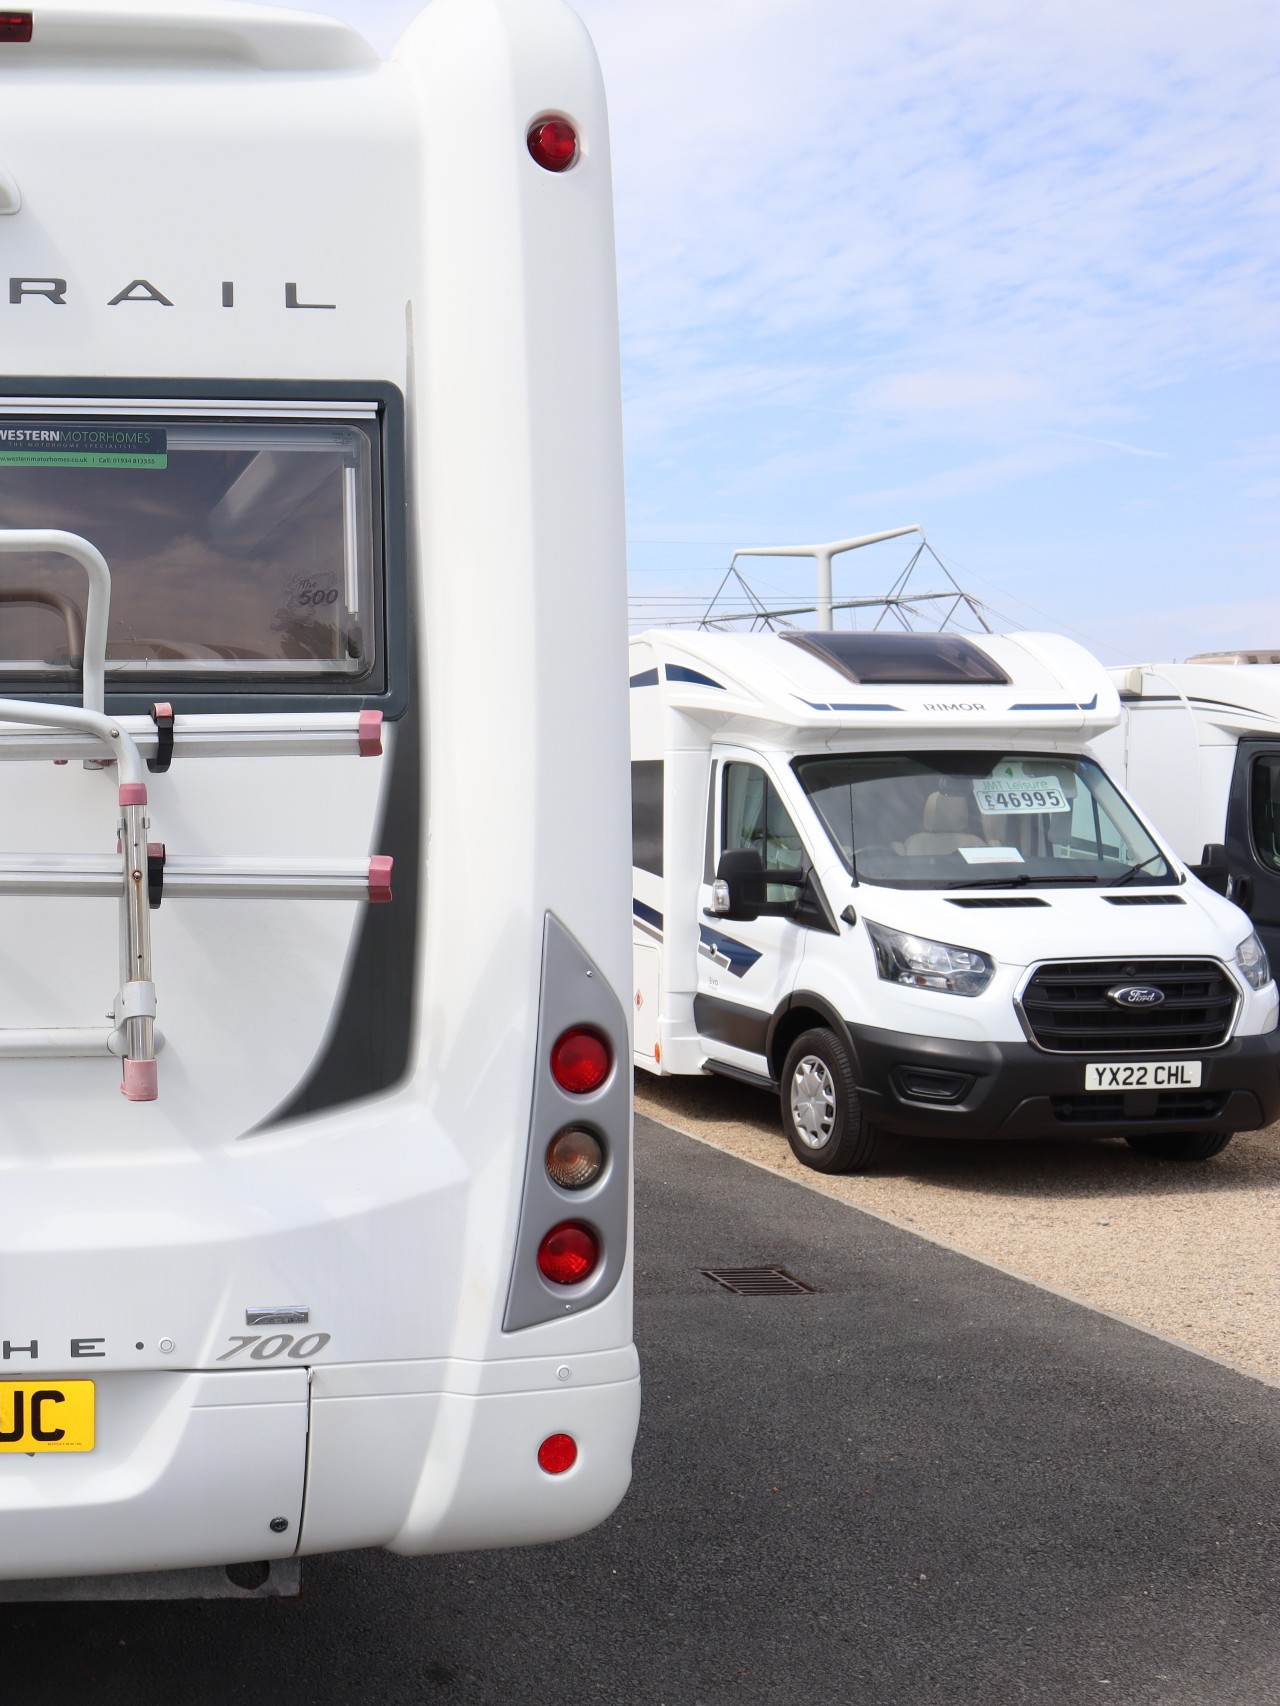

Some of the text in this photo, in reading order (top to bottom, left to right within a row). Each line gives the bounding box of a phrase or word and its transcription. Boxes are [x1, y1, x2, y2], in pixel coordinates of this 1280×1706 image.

[299, 580, 318, 588] The
[299, 589, 339, 605] 500
[923, 703, 987, 711] RIMOR
[983, 781, 1049, 790] JMT Leisure
[985, 791, 1060, 808] £46995
[1128, 989, 1156, 1002] Ford
[1095, 1065, 1191, 1086] YX22 CHL
[215, 1332, 331, 1361] 700
